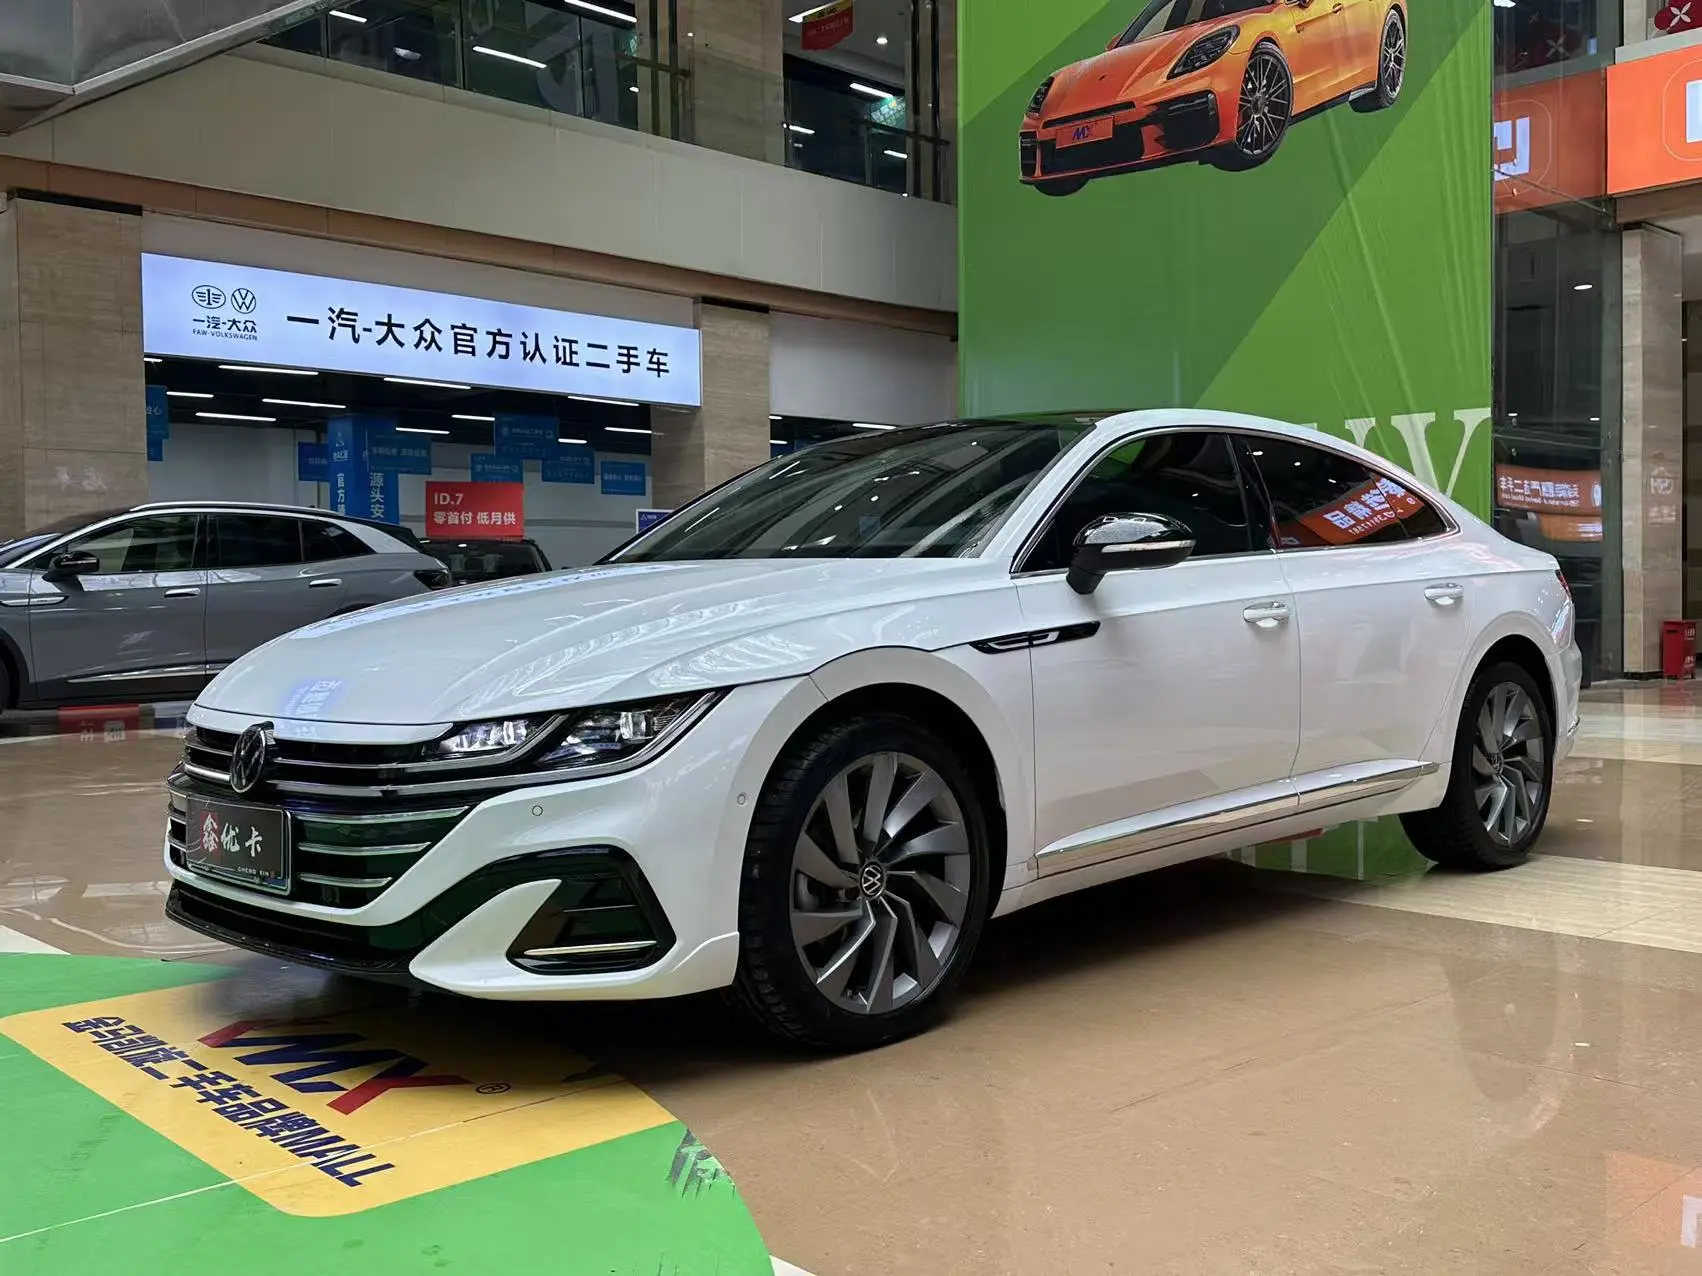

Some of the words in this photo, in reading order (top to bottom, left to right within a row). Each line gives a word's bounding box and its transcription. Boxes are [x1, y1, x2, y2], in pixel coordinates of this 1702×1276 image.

[193, 316, 257, 333] 一汽-大众
[286, 306, 670, 379] 一汽-大众官方认证二手车
[434, 492, 464, 505] ID.7
[433, 511, 473, 525] 零首付
[477, 511, 516, 525] 低月供
